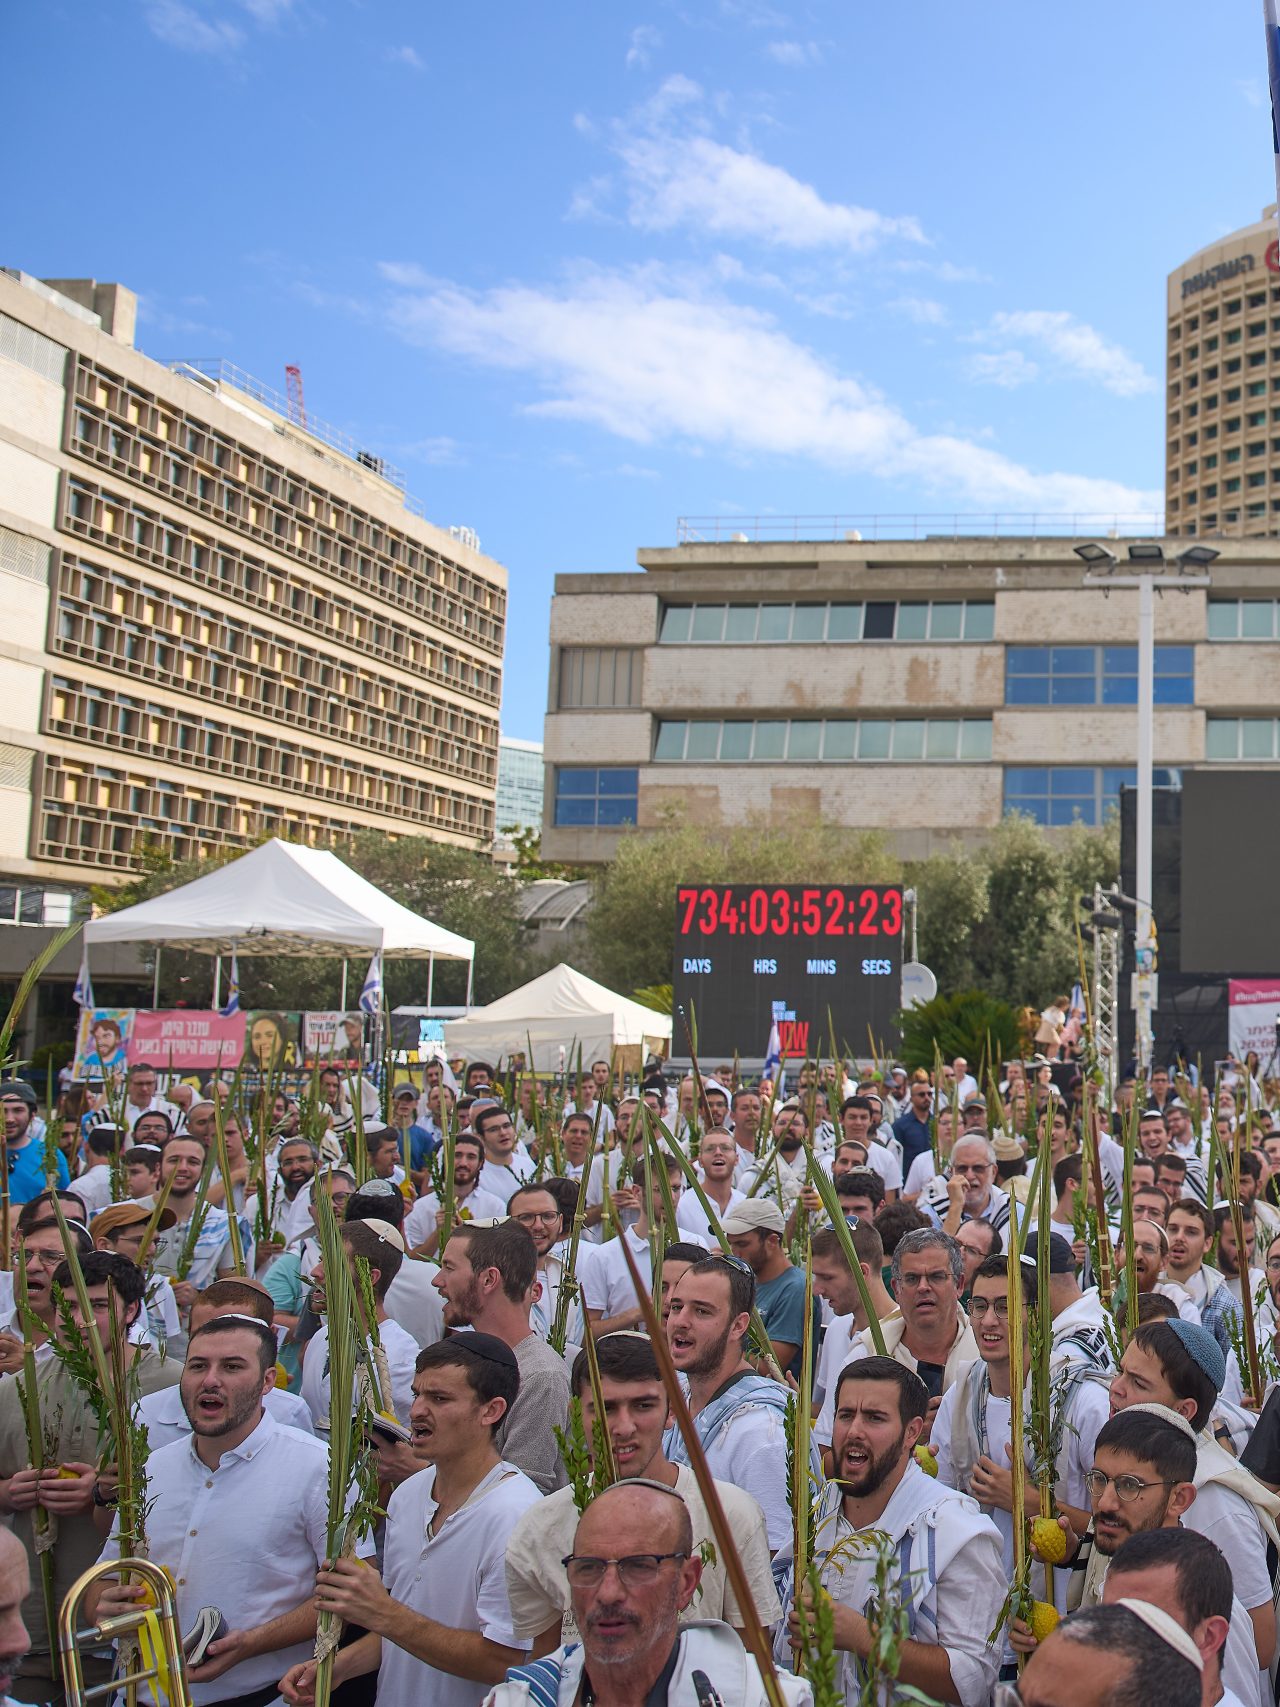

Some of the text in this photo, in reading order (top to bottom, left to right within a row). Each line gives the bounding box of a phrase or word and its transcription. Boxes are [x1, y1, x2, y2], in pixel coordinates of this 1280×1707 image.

[679, 889, 901, 935] 734:03:52:23
[683, 958, 891, 975] DAYS HRS MINS SECS
